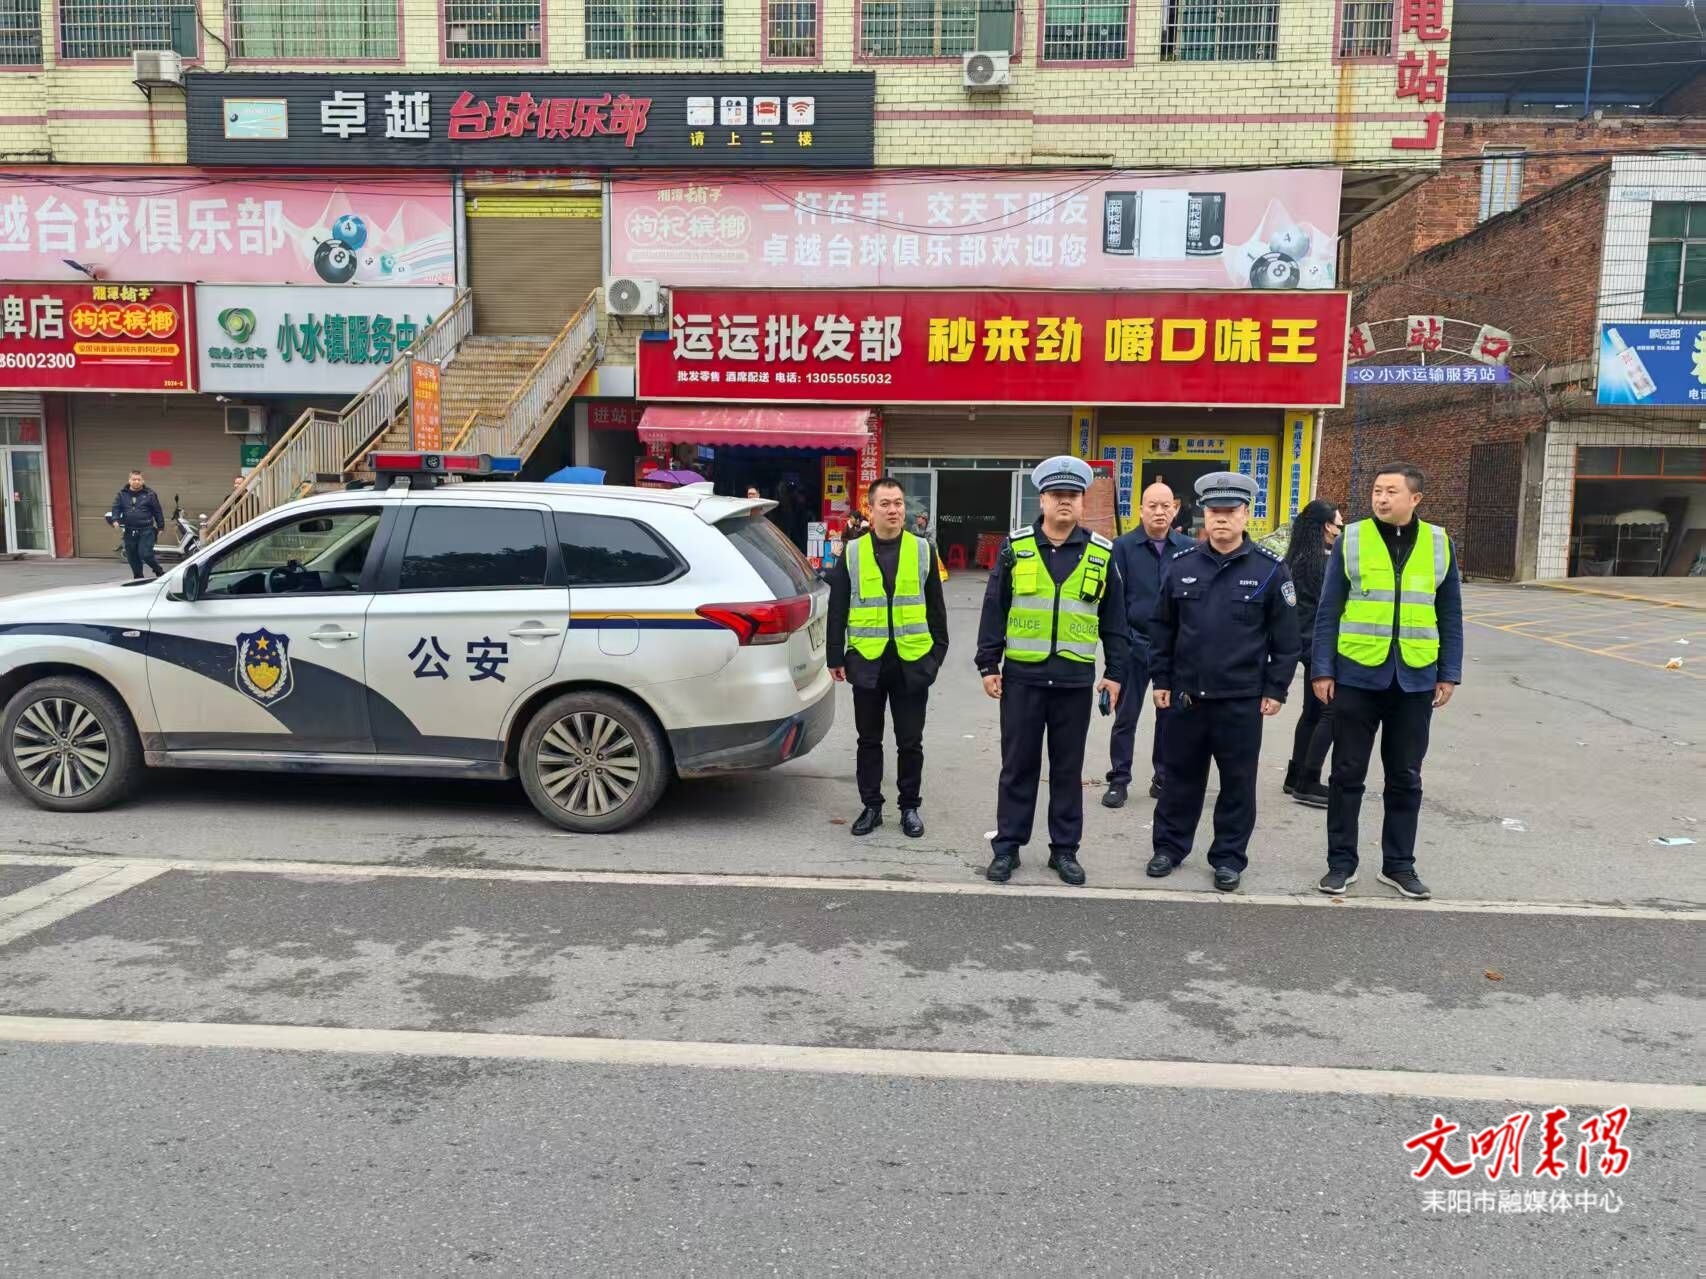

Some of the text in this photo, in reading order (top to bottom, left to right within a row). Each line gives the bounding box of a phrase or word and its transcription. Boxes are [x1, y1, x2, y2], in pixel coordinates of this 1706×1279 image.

[321, 91, 651, 148] 卓越 台球俱乐部
[690, 131, 813, 146] 请上二楼
[631, 213, 746, 238] 枸杞槟榔
[334, 251, 346, 263] 8
[763, 233, 1087, 267] 卓越台球俱乐部欢迎您
[1273, 264, 1286, 278] 8
[73, 309, 173, 332] 枸杞槟榔
[673, 314, 1318, 363] 运运批发部 秒来劲 嚼口味王
[678, 371, 720, 382] 批发零售
[725, 372, 770, 383] 酒席配送
[806, 374, 892, 384] 13055055032
[1378, 367, 1496, 382] 小水运输服务站
[1009, 617, 1040, 629] POLICE
[1070, 623, 1098, 634] POLICE
[408, 636, 509, 683] 公安
